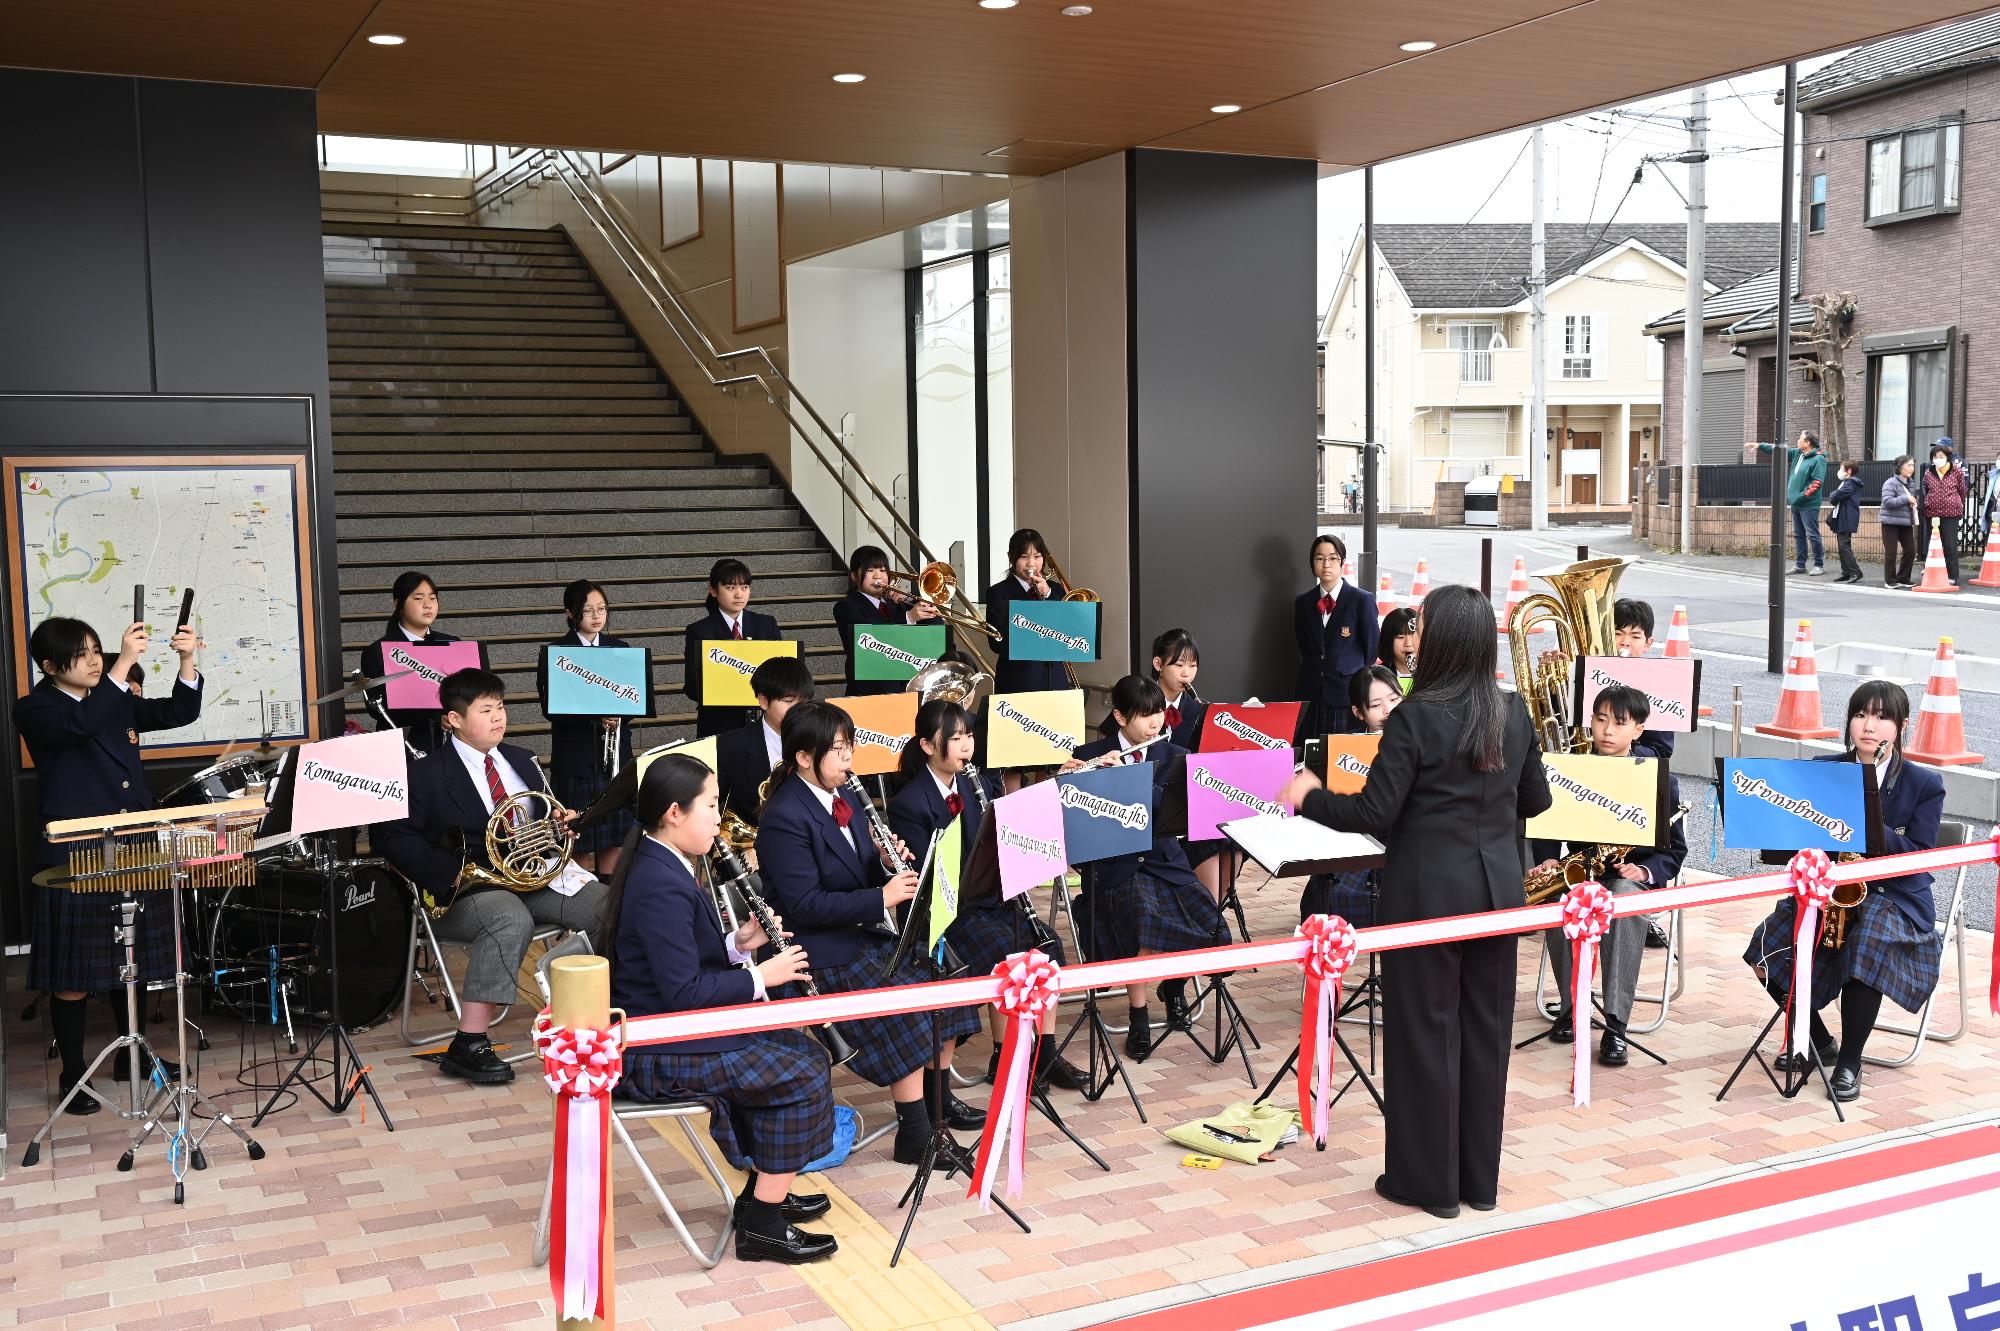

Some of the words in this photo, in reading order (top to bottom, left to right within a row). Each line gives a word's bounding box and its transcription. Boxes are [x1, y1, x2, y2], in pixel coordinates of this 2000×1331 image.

[710, 648, 757, 675] Komaga
[303, 761, 405, 802] Komagawa.jhs,
[1060, 784, 1147, 828] Komagawa.jhs,
[341, 880, 376, 912] Pearl
